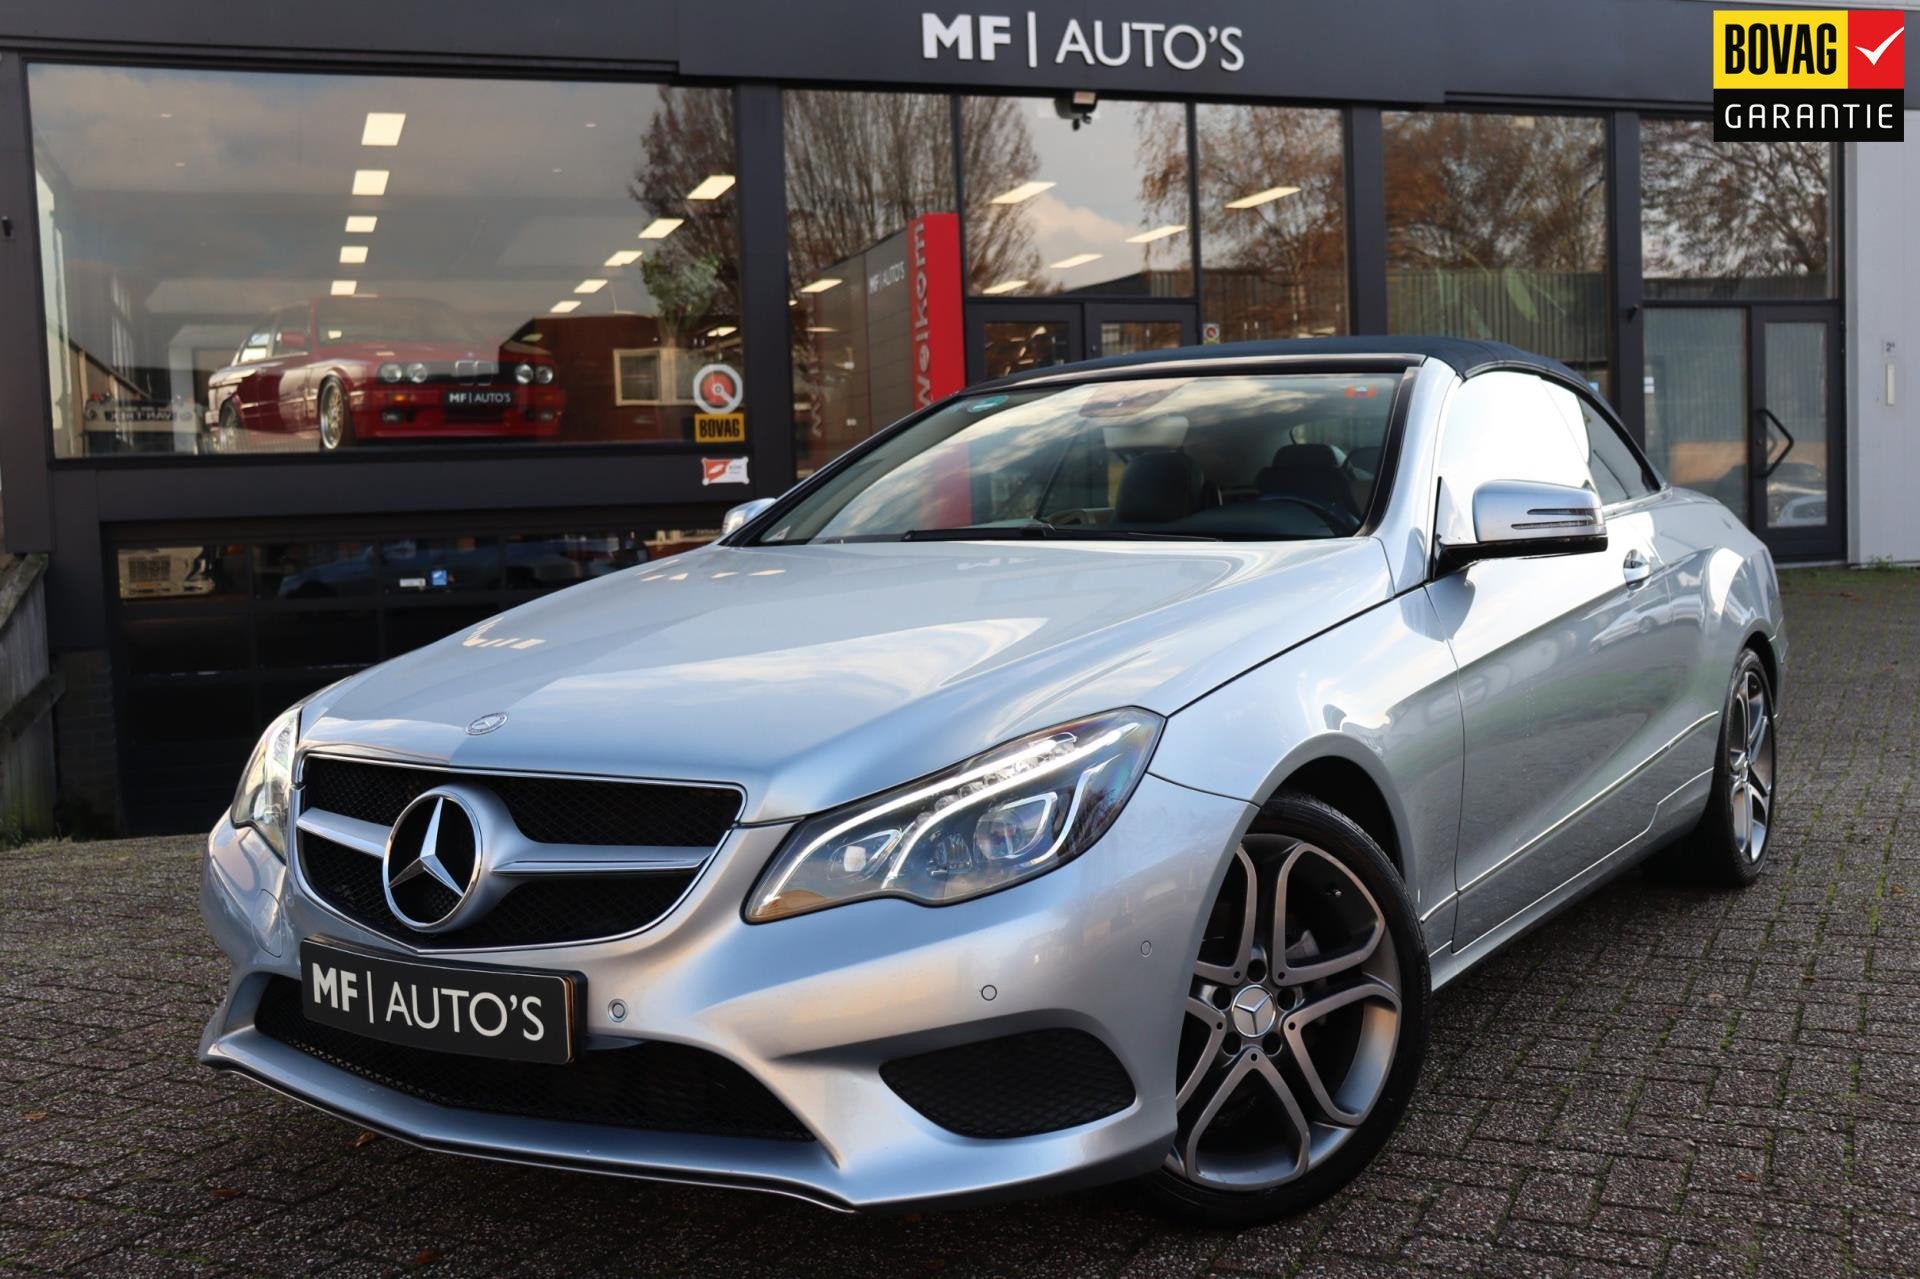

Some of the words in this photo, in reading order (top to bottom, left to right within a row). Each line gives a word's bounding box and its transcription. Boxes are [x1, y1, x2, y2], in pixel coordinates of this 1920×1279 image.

[922, 12, 1012, 61] MF
[1055, 18, 1245, 71] AUTO'S
[449, 392, 467, 403] MF
[474, 392, 512, 403] AUTO'S
[699, 418, 740, 438] BOVAG
[311, 962, 358, 1013] MF
[385, 980, 545, 1042] AUTO'S
